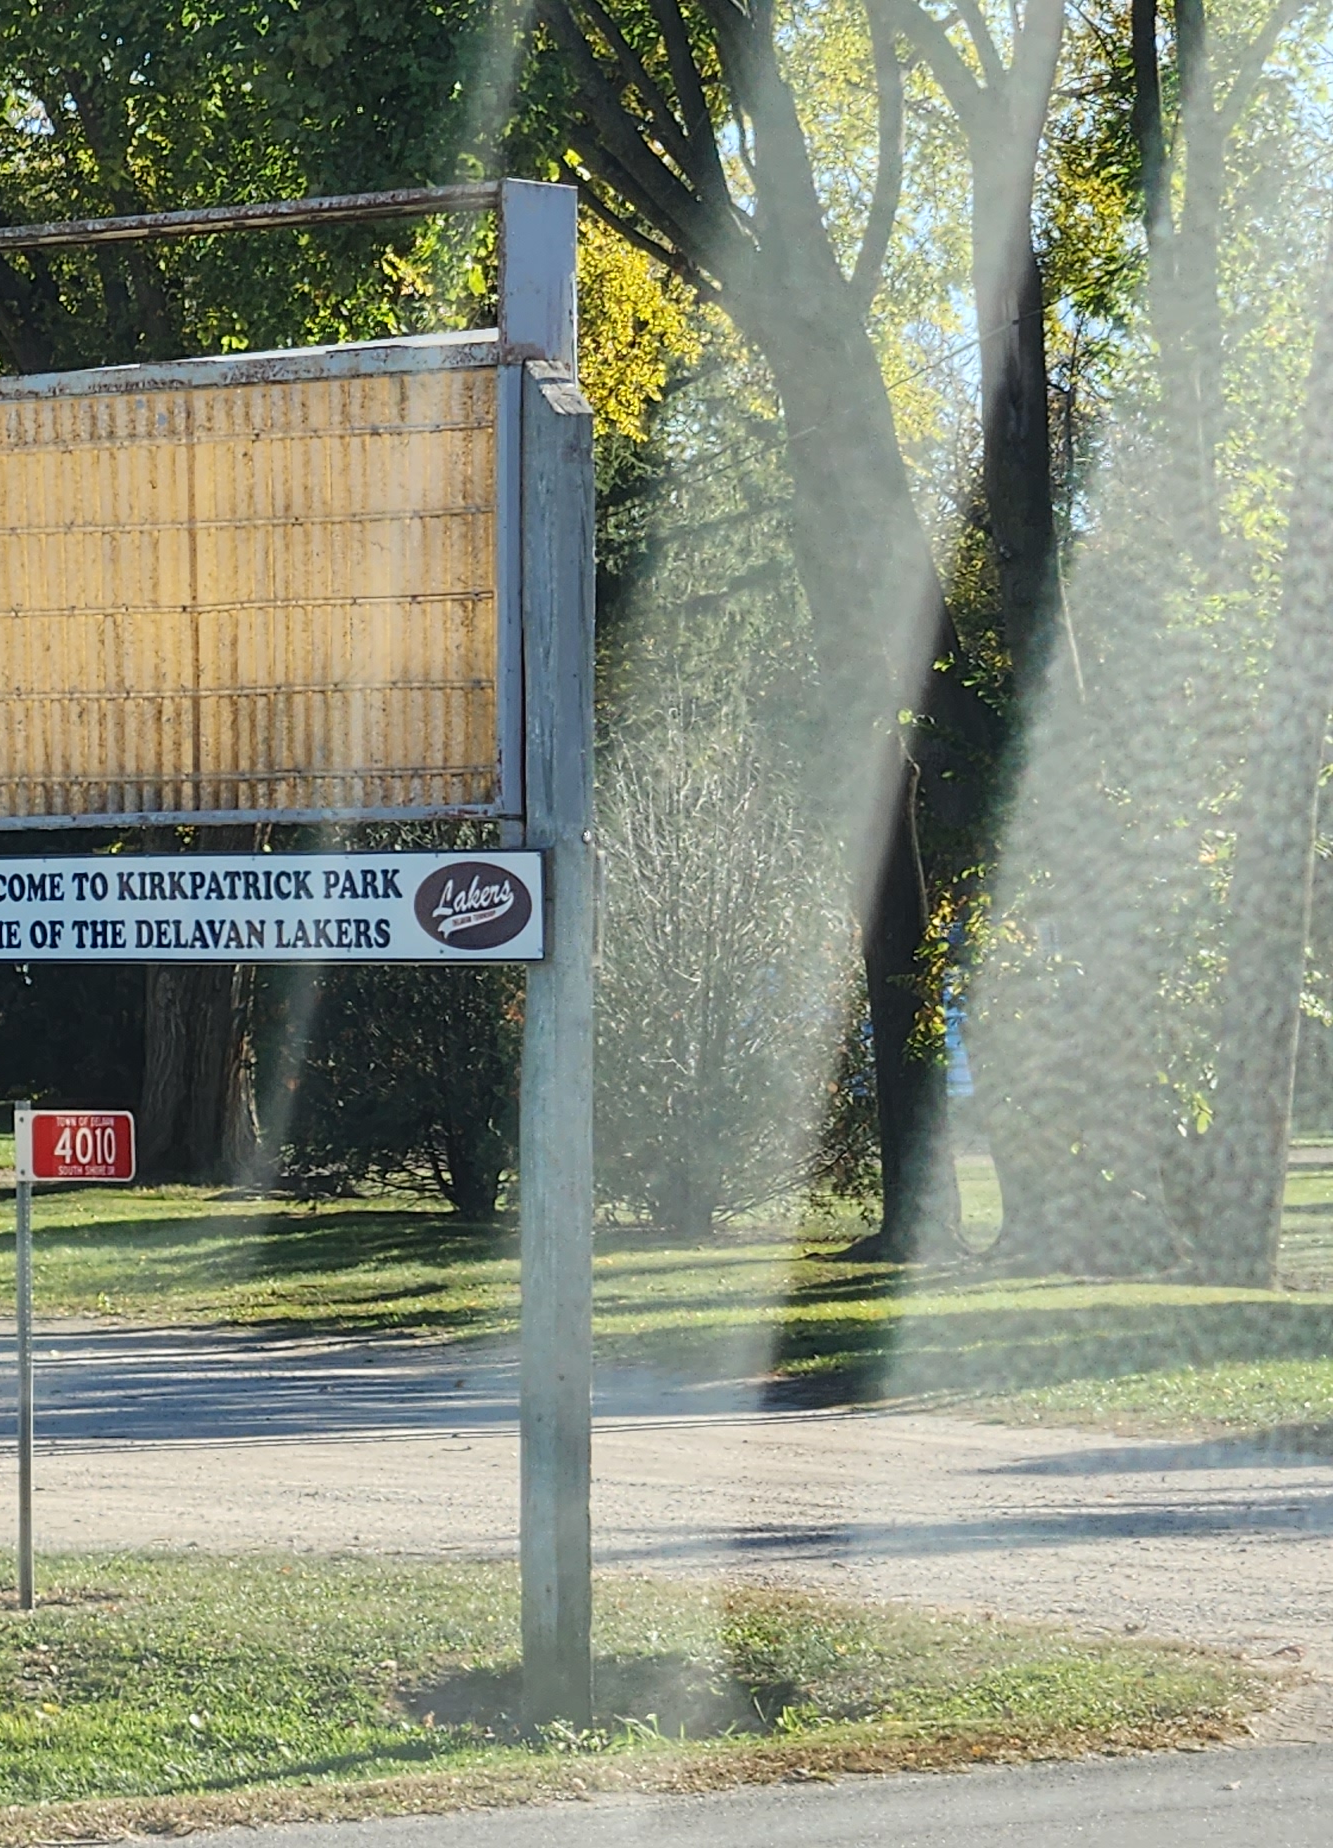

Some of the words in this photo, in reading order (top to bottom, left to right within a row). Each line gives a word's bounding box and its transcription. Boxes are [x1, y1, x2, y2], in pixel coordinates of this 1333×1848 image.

[72, 871, 109, 901] TO
[116, 870, 314, 901] KIRKPATRICK
[322, 869, 403, 899] PARK
[432, 874, 514, 918] Lakers
[29, 920, 65, 949] OF
[72, 919, 127, 949] THE
[134, 919, 266, 949] DELAVAN
[274, 918, 391, 949] LAKERS
[54, 1127, 116, 1165] 4010
